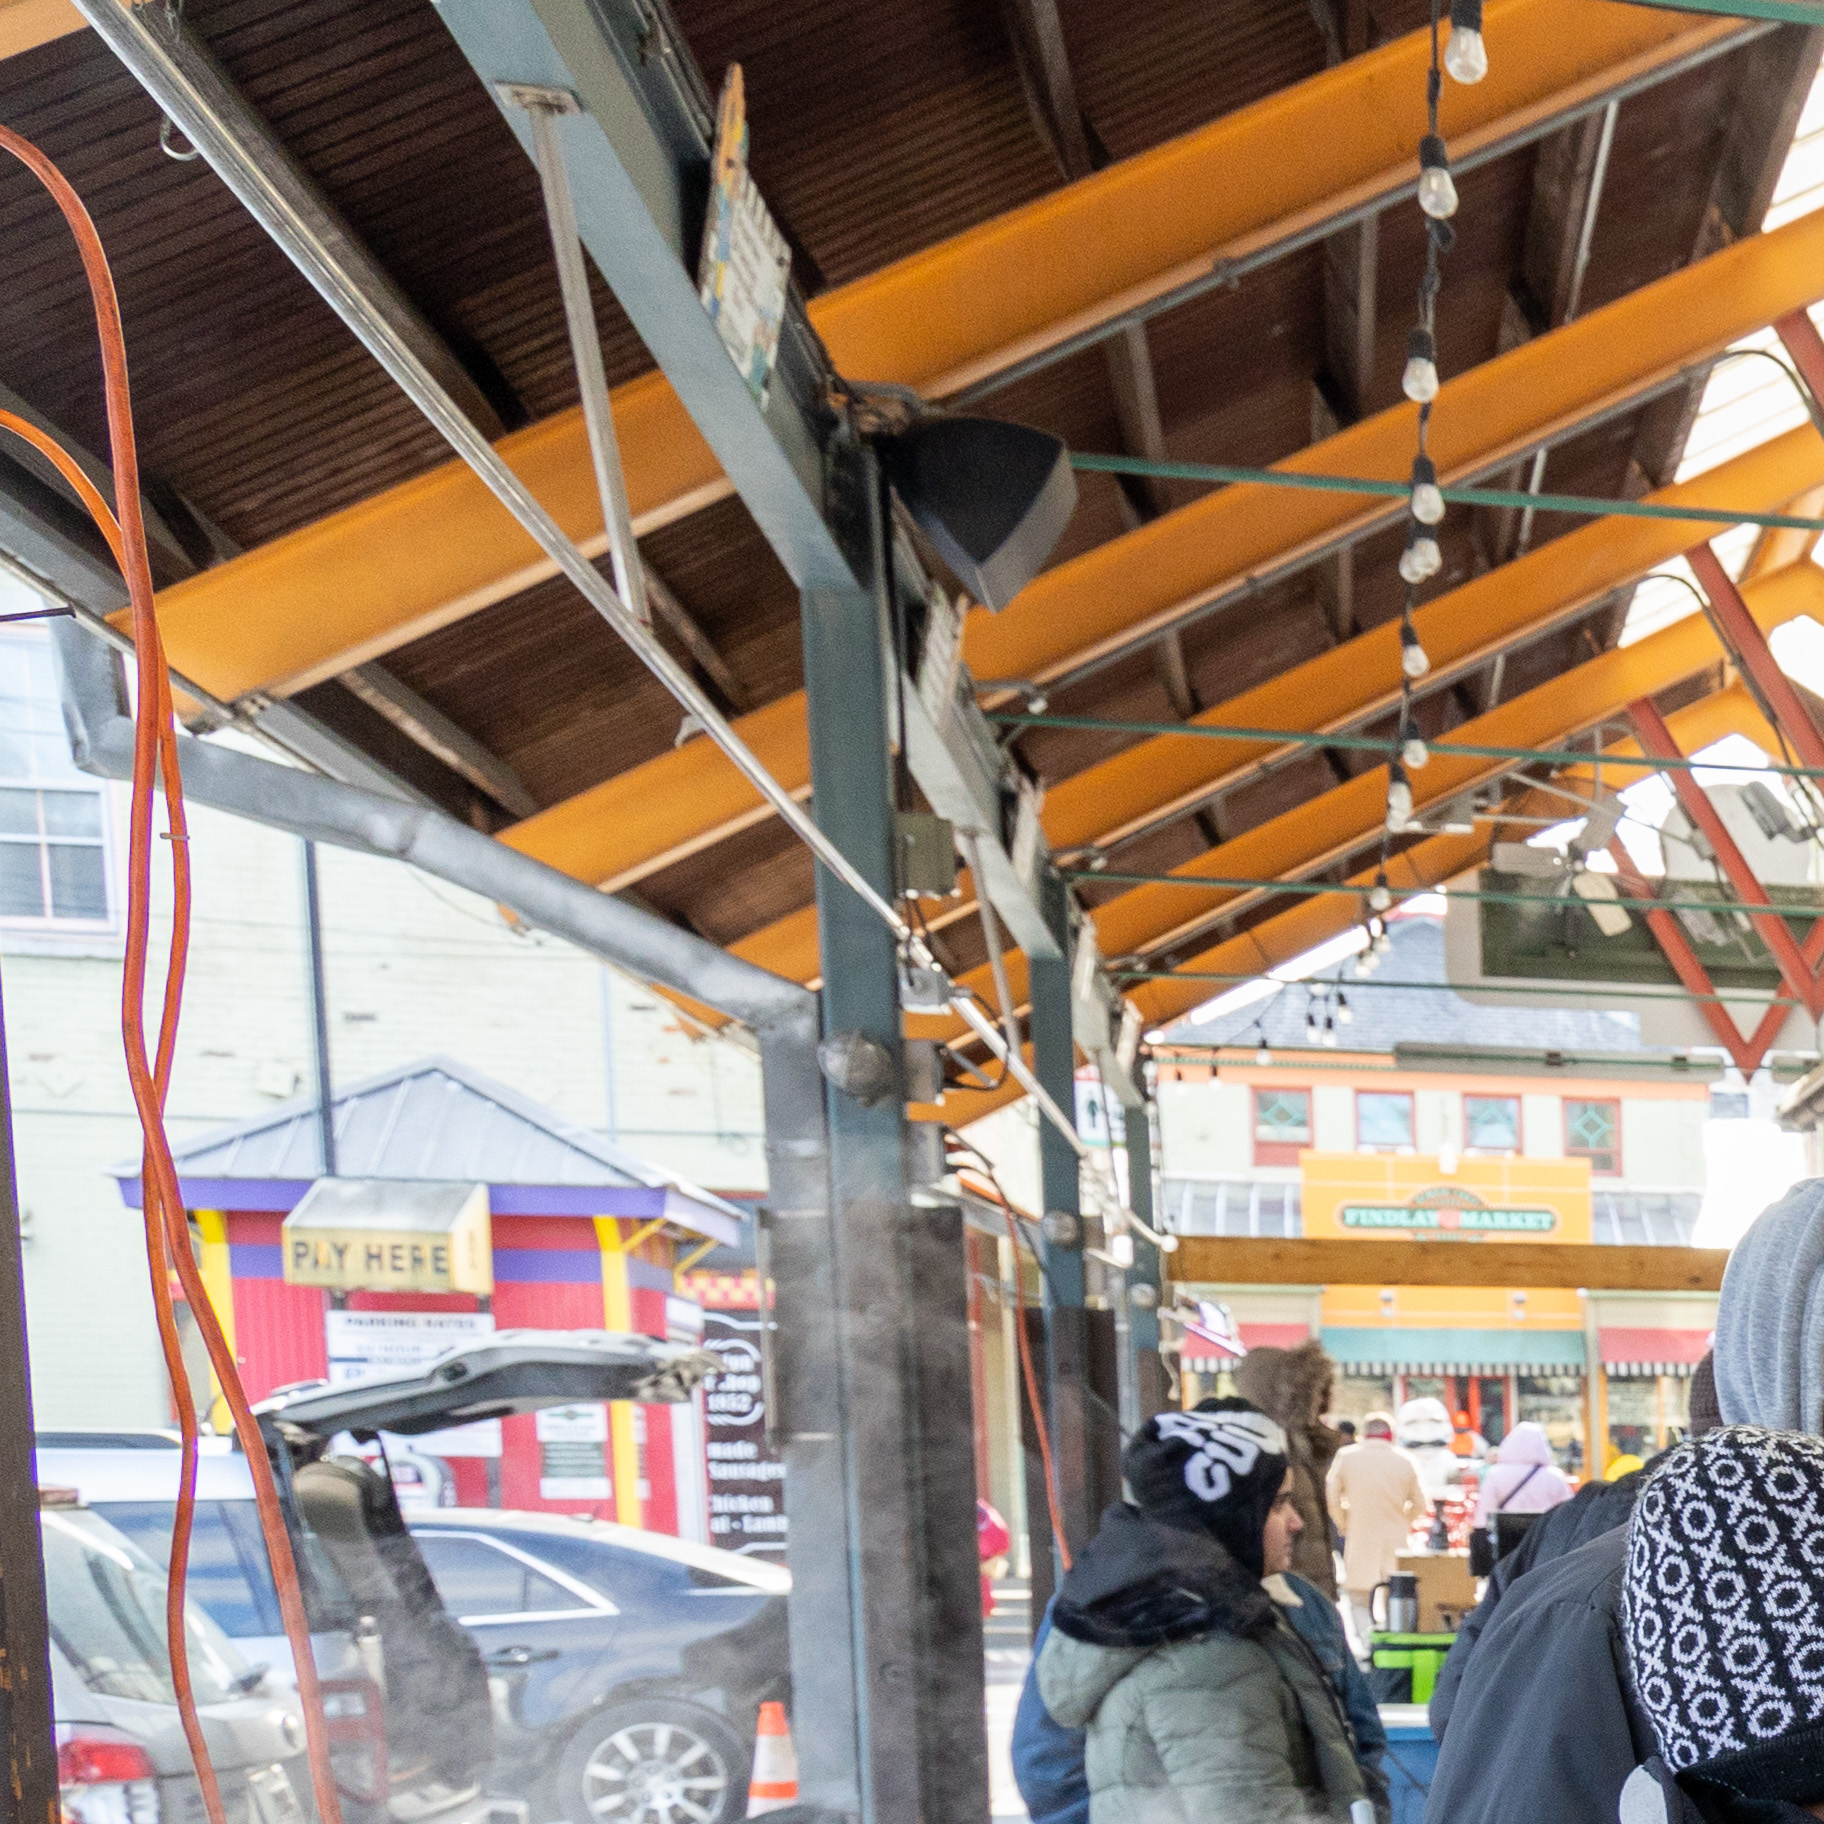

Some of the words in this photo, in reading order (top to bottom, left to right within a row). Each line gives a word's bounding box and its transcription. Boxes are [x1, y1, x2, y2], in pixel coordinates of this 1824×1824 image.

[1344, 1207, 1438, 1226] FINDLAY
[1460, 1210, 1555, 1231] MARKET
[710, 1494, 774, 1514] hicken
